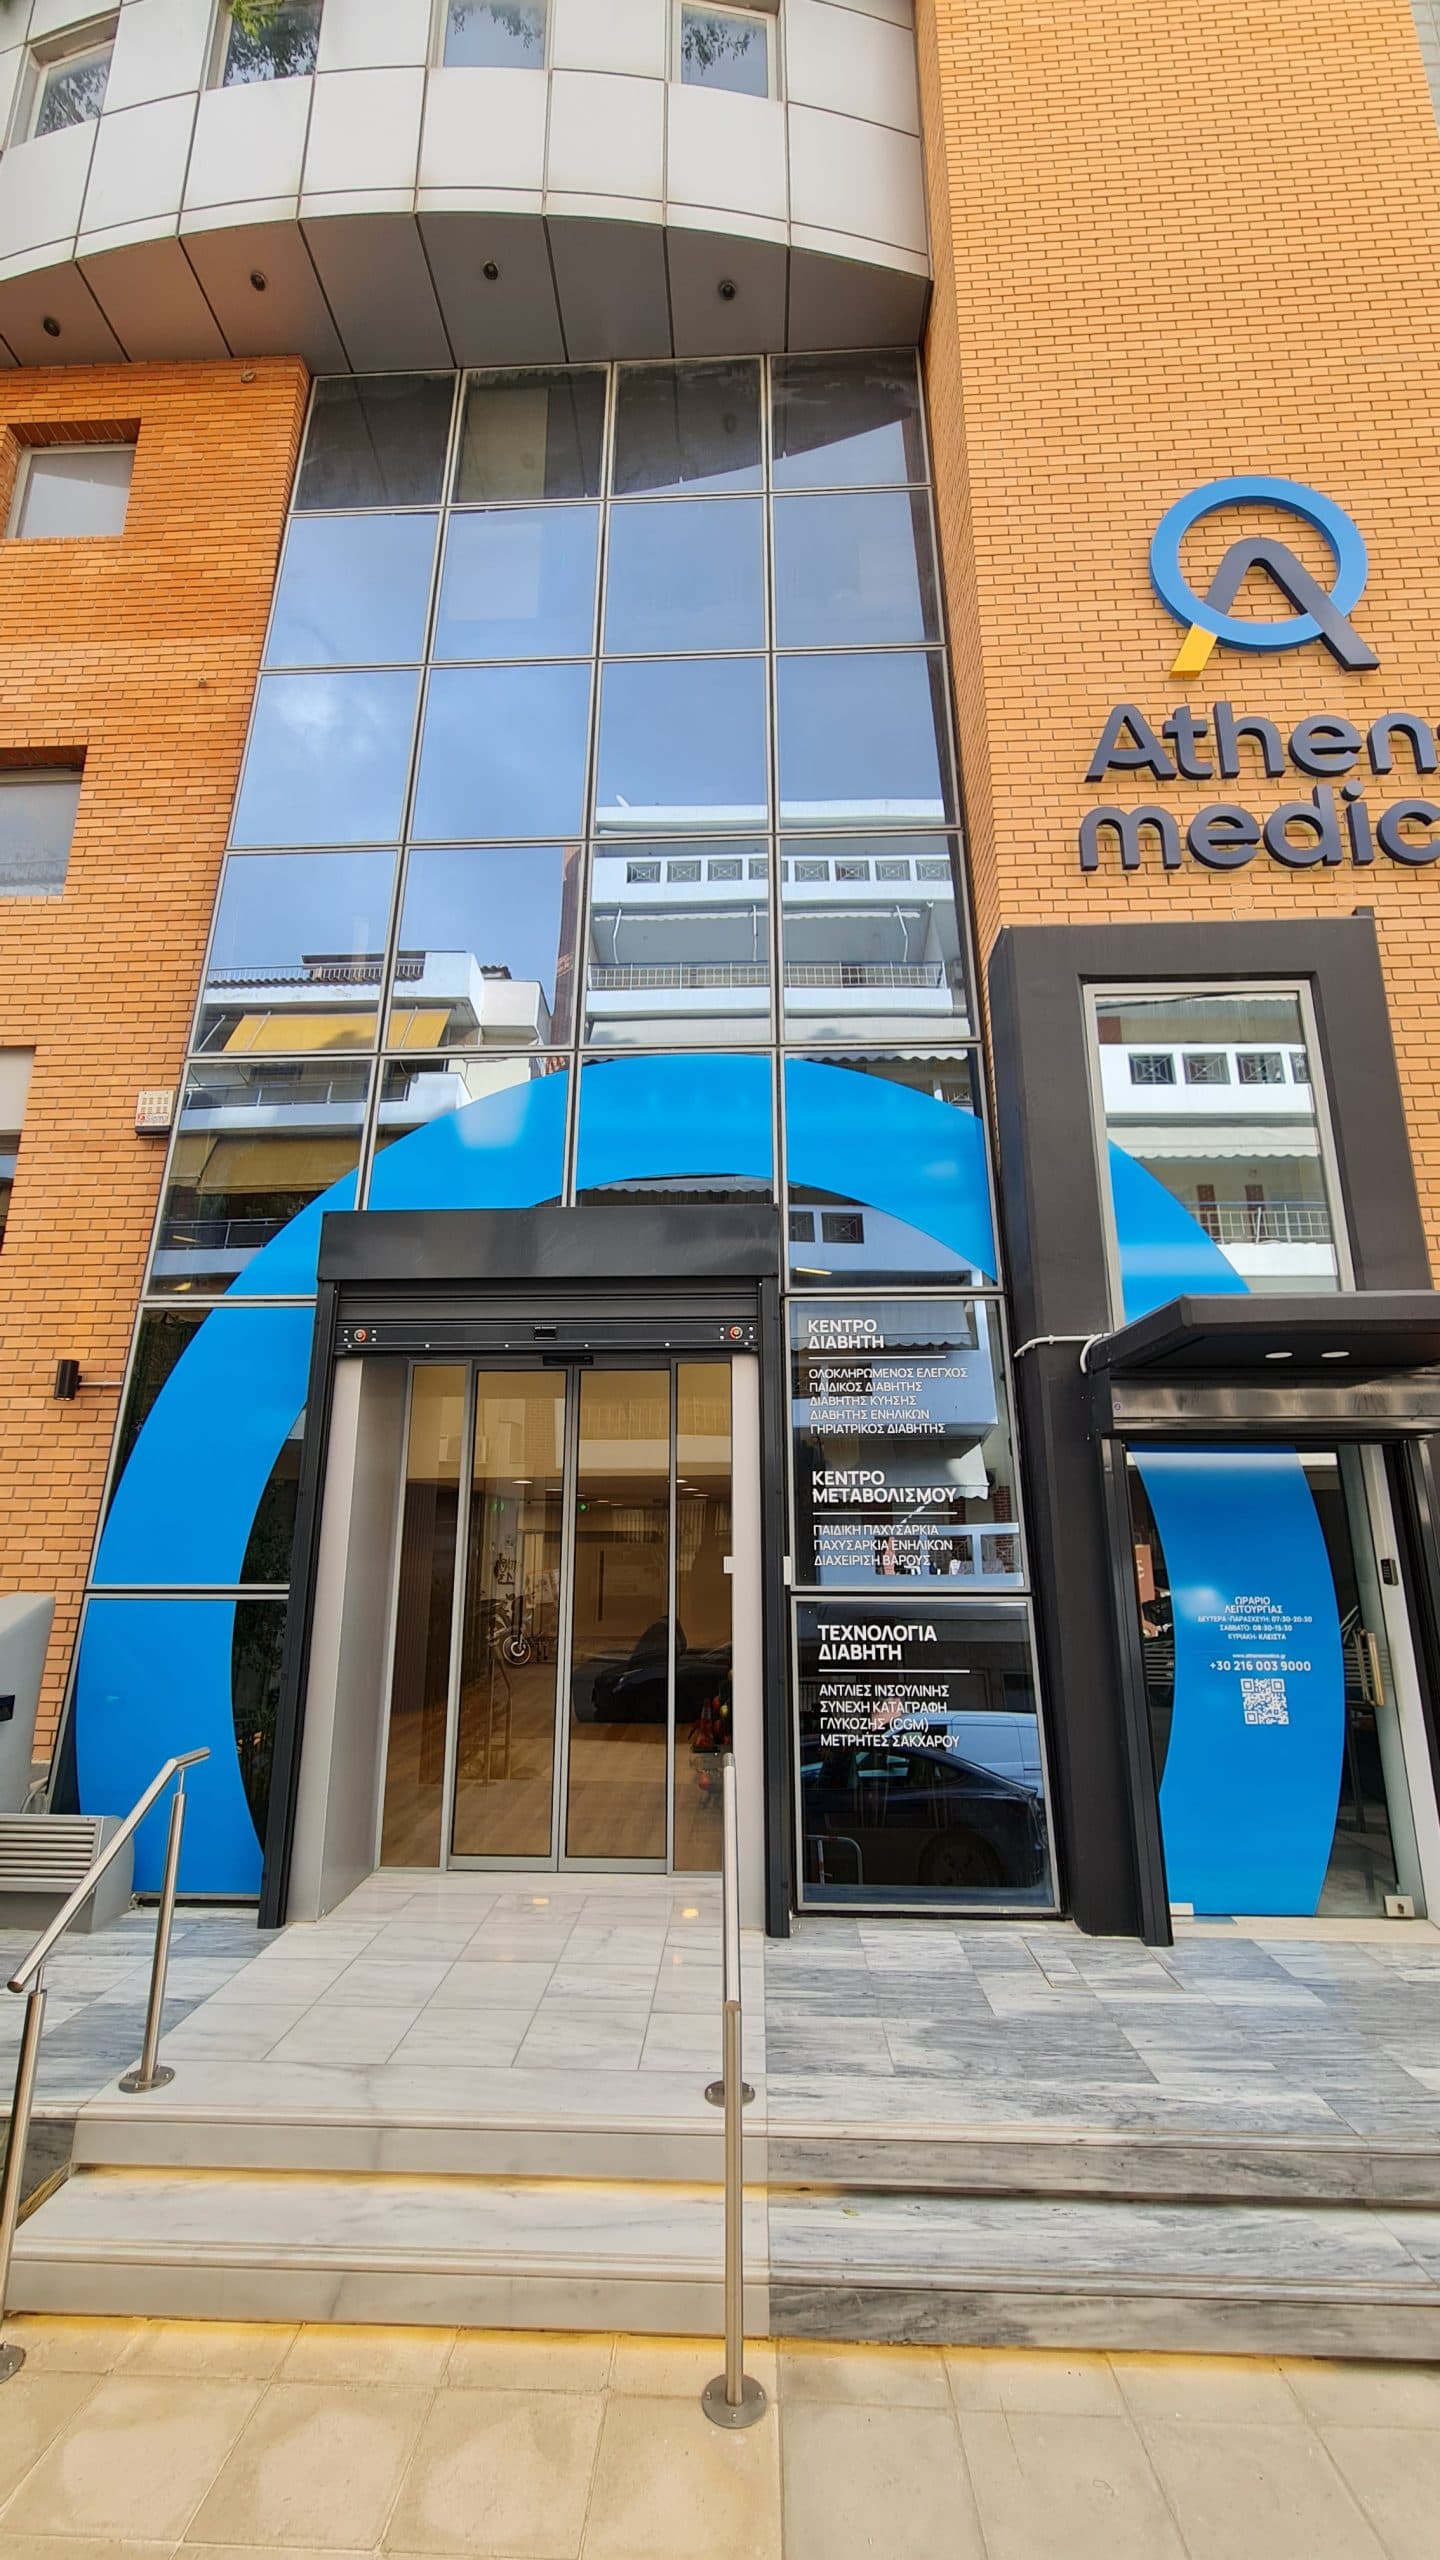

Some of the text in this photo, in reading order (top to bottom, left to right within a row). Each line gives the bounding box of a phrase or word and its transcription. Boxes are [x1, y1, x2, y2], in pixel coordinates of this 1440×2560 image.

[1085, 701, 1440, 782] Athen
[808, 1319, 877, 1333] ΚΕΝΤΡΟ
[808, 1335, 884, 1349] ΔΙΑΒΗΤΗ
[809, 1367, 968, 1379] ΟΛΟΚΛΗΡΩΜΕΝΟΣ ΕΛΕΓΧΟΣ
[809, 1381, 922, 1393] ΠΑΙΔΙΚΟΣ ΔΙΑΒΗΤΗΣ
[809, 1395, 917, 1407] ΔΙΑΒΗΤΗΣ ΚΥΗΣΗΣ
[810, 1409, 930, 1421] ΔΙΑΒΗΤΗΣ ΕΝΗΛΙΚΩΝ
[810, 1423, 945, 1435] ΓΗΡΙΑΤΡΙΚΟΣ ΔΙΑΒΗΤΗΣ
[812, 1471, 885, 1486] ΚΕΝΤΡΟ
[812, 1488, 957, 1503] ΜΕΤΑΒΟΛΙΣΜΟΥ
[813, 1525, 939, 1536] ΠΑΙΔΙΚΗ ΠΑΧΥΣΑΡΚΙΑ
[814, 1540, 953, 1551] ΠΑΧΥΣΑΡΚΙΑ ΕΝΗΛΙΚΩΝ
[814, 1555, 931, 1566] ΔΙΑΧΕΙΡΙΣΗ ΒΑΡΟΥΣ
[1235, 1596, 1271, 1605] ΩΡΑΡΙΟ
[1224, 1605, 1283, 1614] ΛΕΙΤΟΥΡΓΙΑΣ
[818, 1625, 937, 1642] ΤΕΧΝΟΛΟΓΙΑ
[818, 1644, 902, 1661] ΔΙΑΒΗΤΗ
[1209, 1661, 1312, 1671] +30 216 003 9000
[819, 1684, 950, 1697] ΑΝΤΛΙΕΣ ΙΝΣΟΥΛΙΝΗΣ
[820, 1701, 947, 1713] ΣΥΝΕΧΗ ΚΑΤΑΓΡΑΦΗ
[820, 1718, 929, 1733] ΓΛΥΚΟΖΗΣ (CGM)
[821, 1735, 960, 1748] ΜΕΤΡΗΤΕΣ ΣΑΚΧΑΡΟΥ
